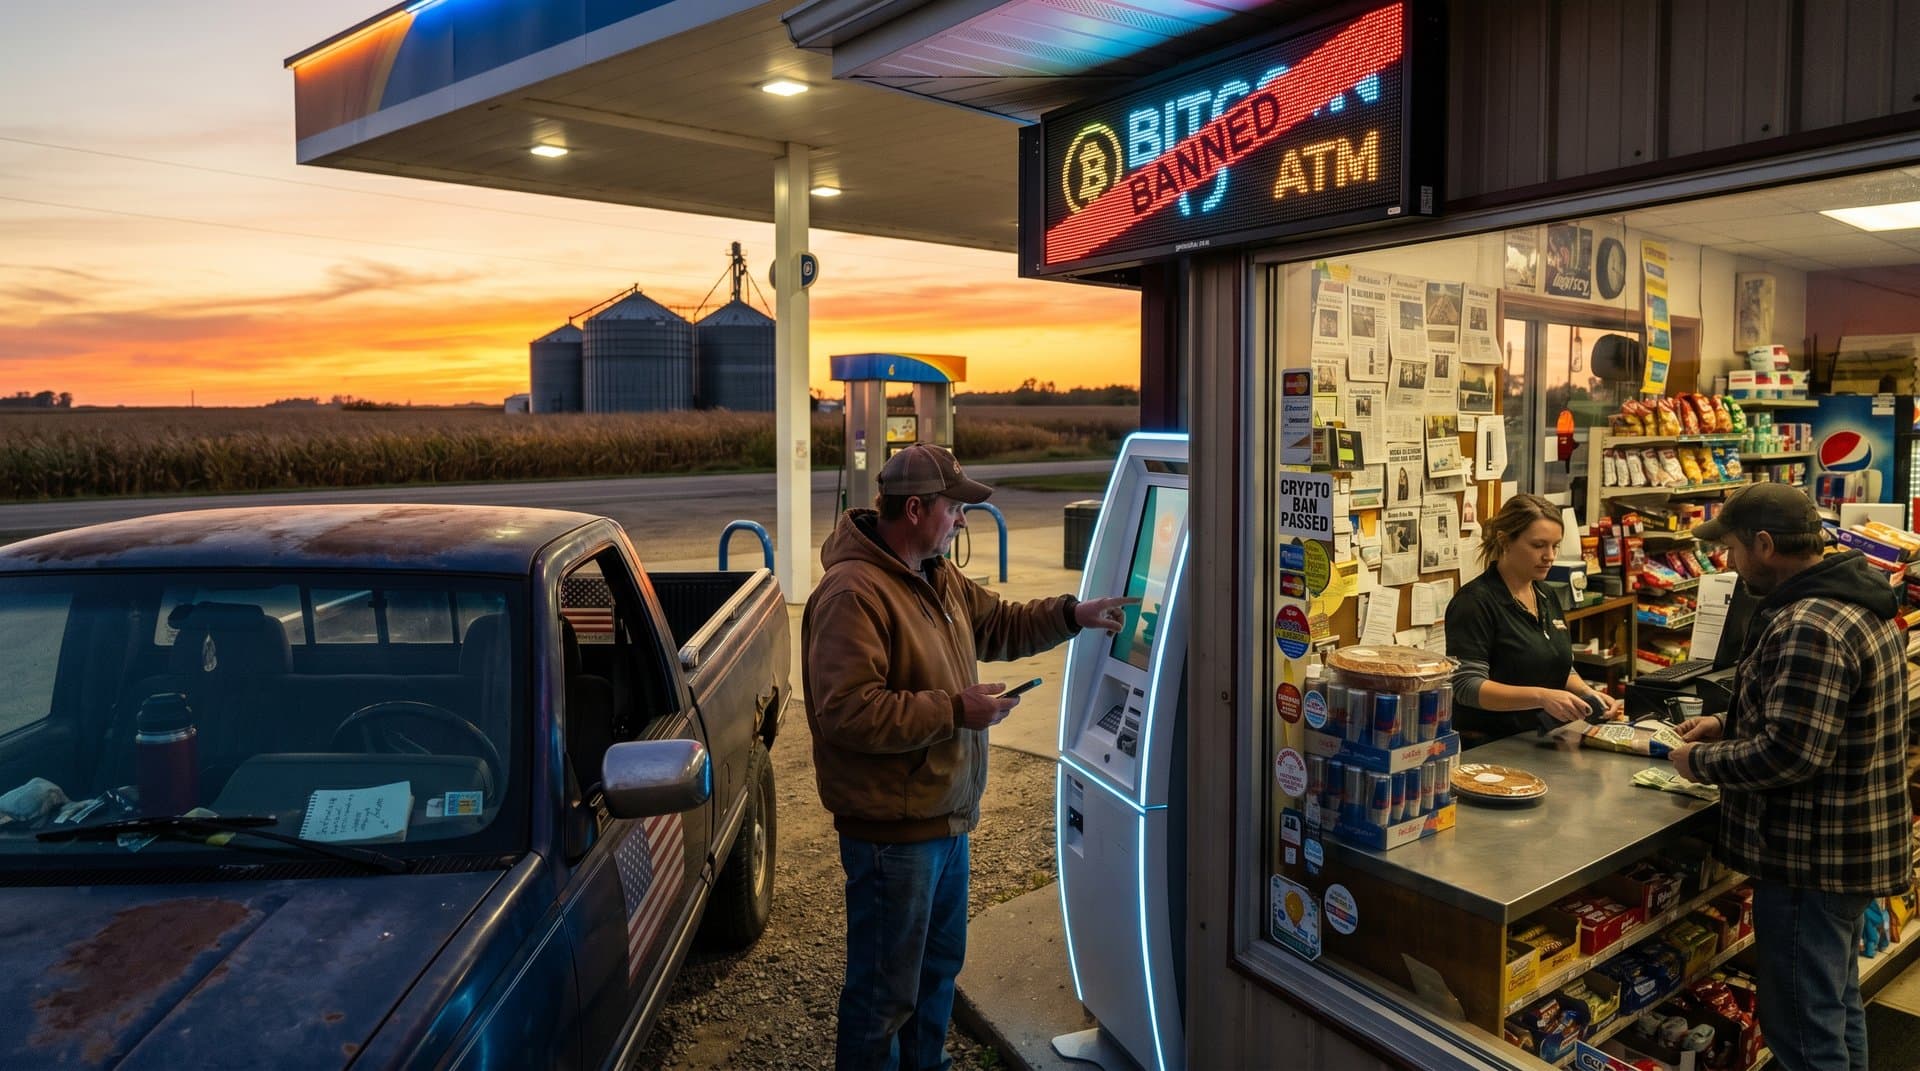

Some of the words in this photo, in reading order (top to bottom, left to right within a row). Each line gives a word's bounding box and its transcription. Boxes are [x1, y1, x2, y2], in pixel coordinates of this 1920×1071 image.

[1129, 92, 1280, 215] BANNED
[1273, 130, 1379, 199] ATM
[1281, 479, 1330, 499] CRYPTO
[1292, 497, 1318, 514] BAN
[1281, 513, 1329, 532] PASSED
